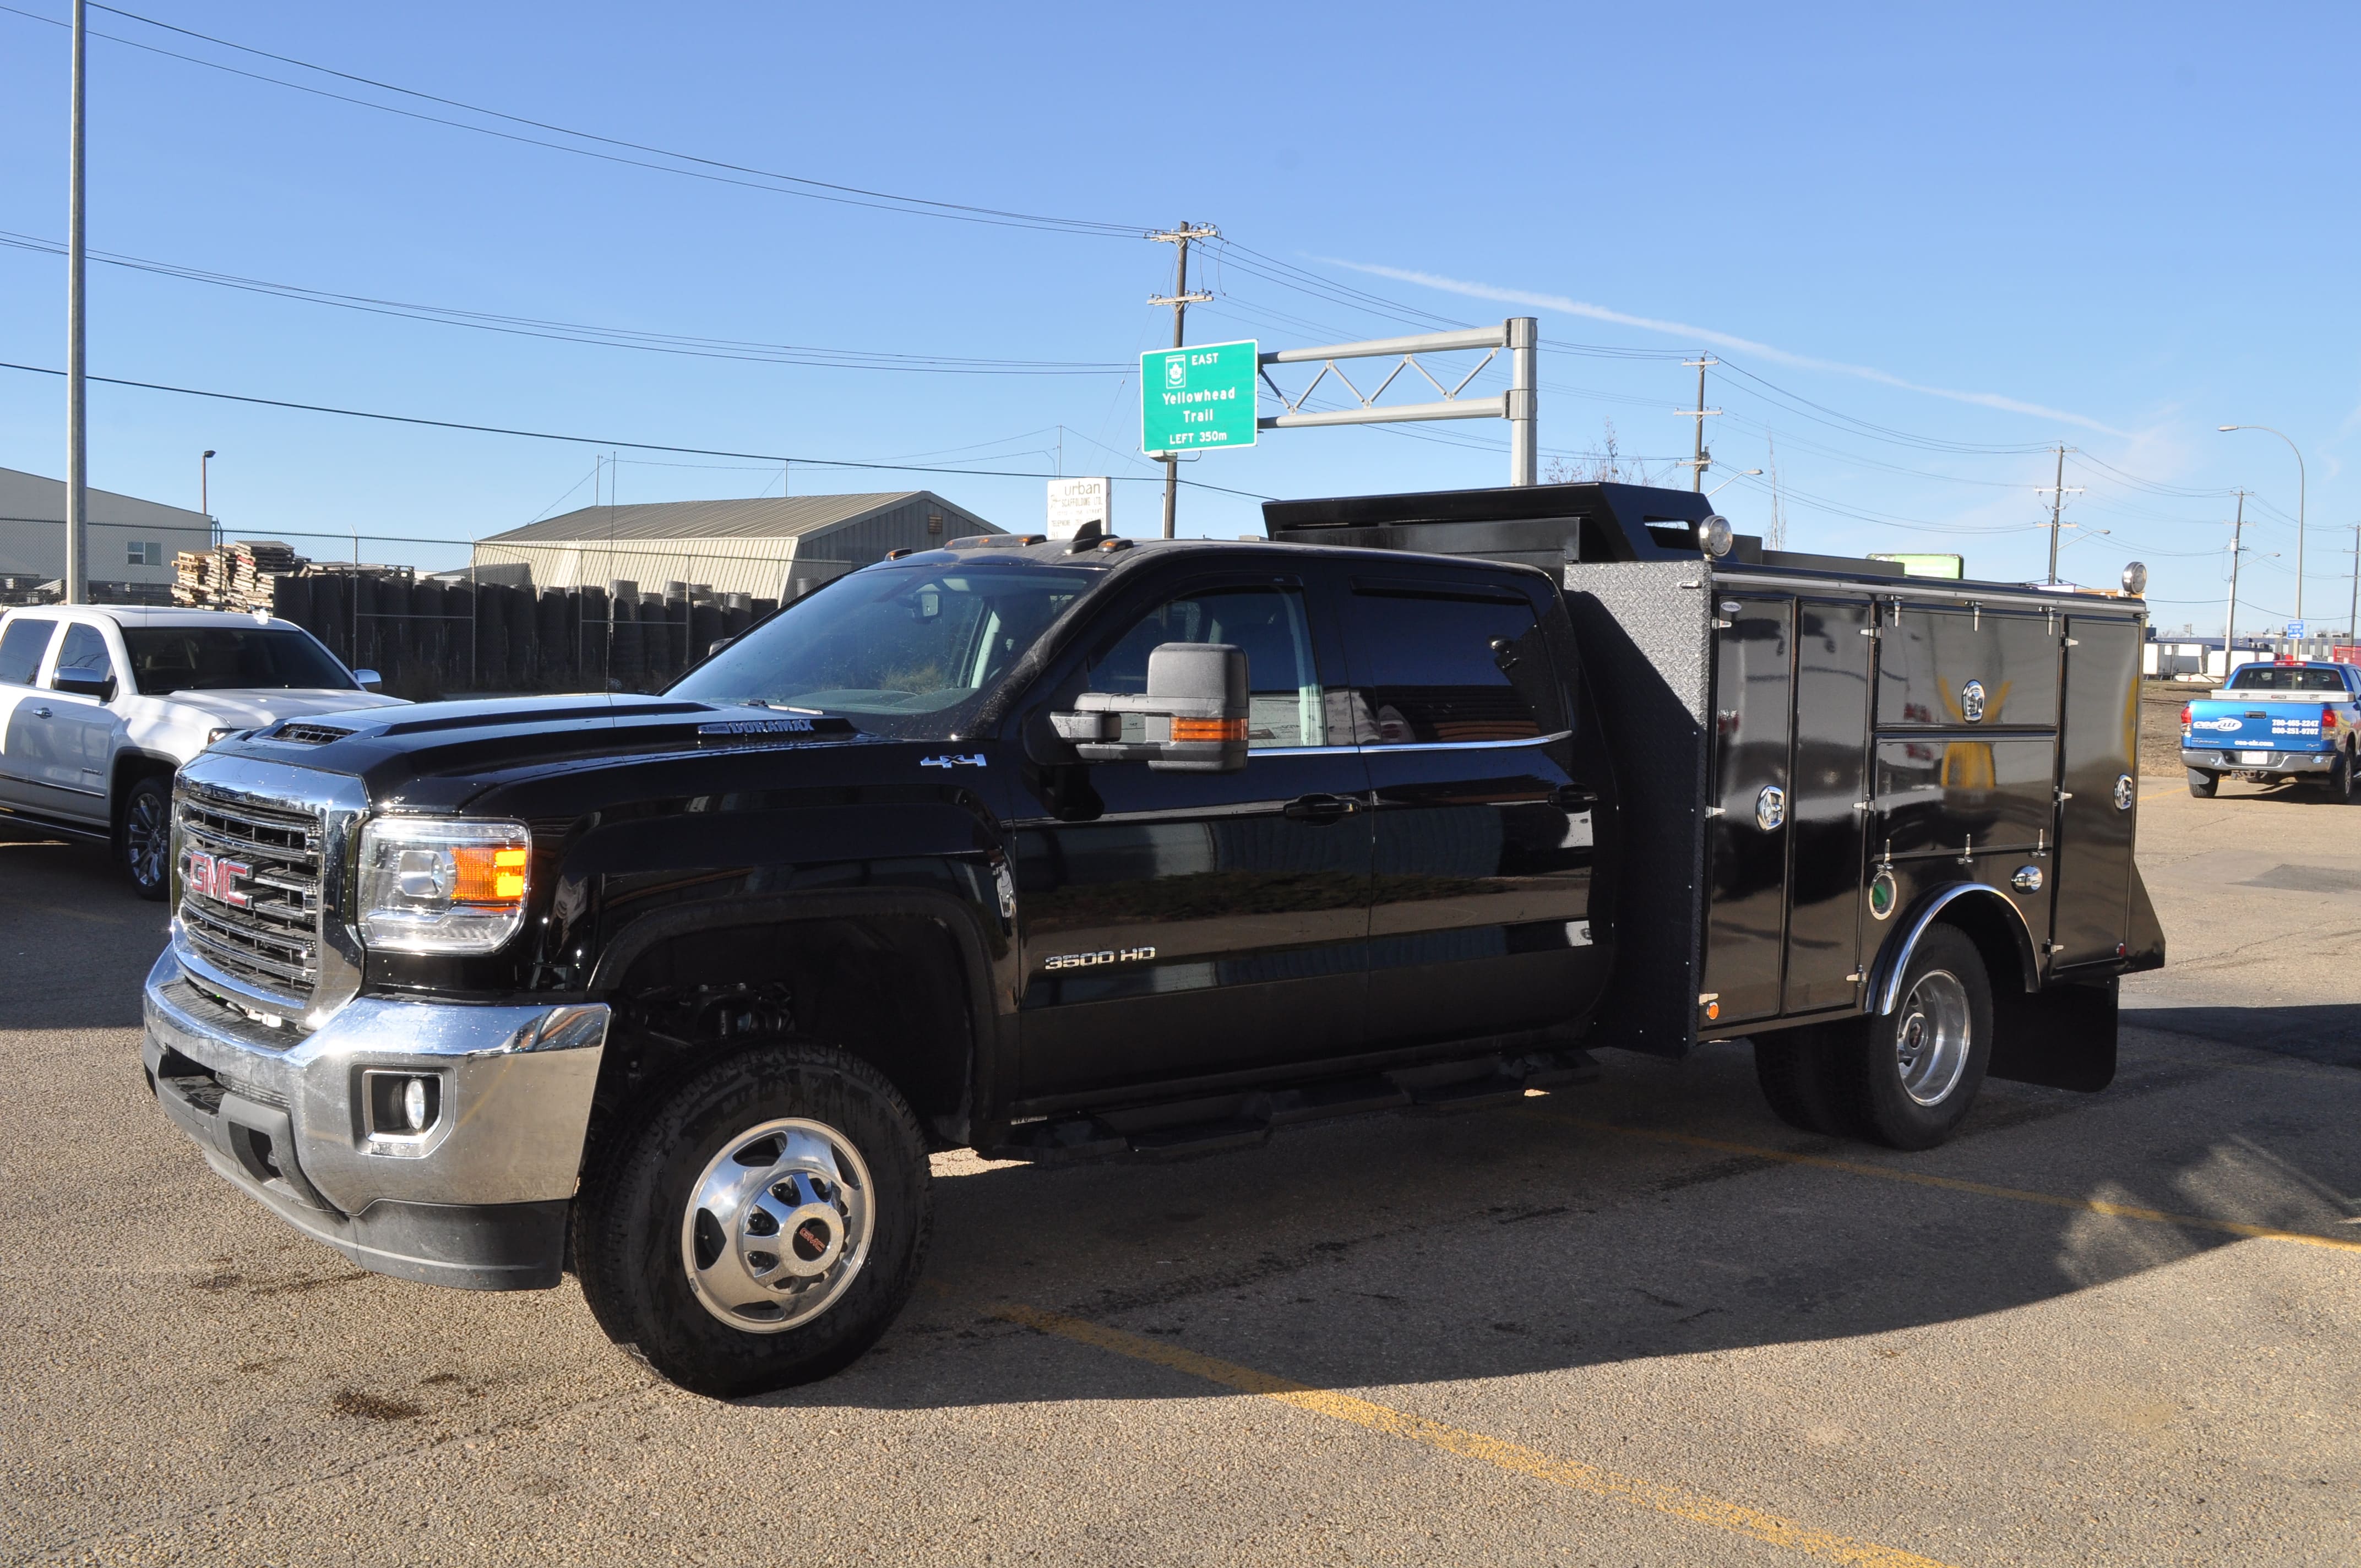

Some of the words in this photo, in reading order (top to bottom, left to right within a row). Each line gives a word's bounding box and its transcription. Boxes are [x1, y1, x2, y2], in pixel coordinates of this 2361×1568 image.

[1192, 352, 1219, 366] EAST
[1162, 386, 1235, 405] Yellowhead
[1183, 409, 1214, 423] Trail
[1169, 433, 1194, 445] LEFT
[1199, 431, 1227, 442] 350m
[1064, 481, 1101, 496] urban
[728, 719, 815, 734] DURAMAX
[189, 850, 253, 910] GMC
[1045, 951, 1114, 970] 3500
[1120, 946, 1156, 961] HD
[799, 1227, 826, 1253] GMC
